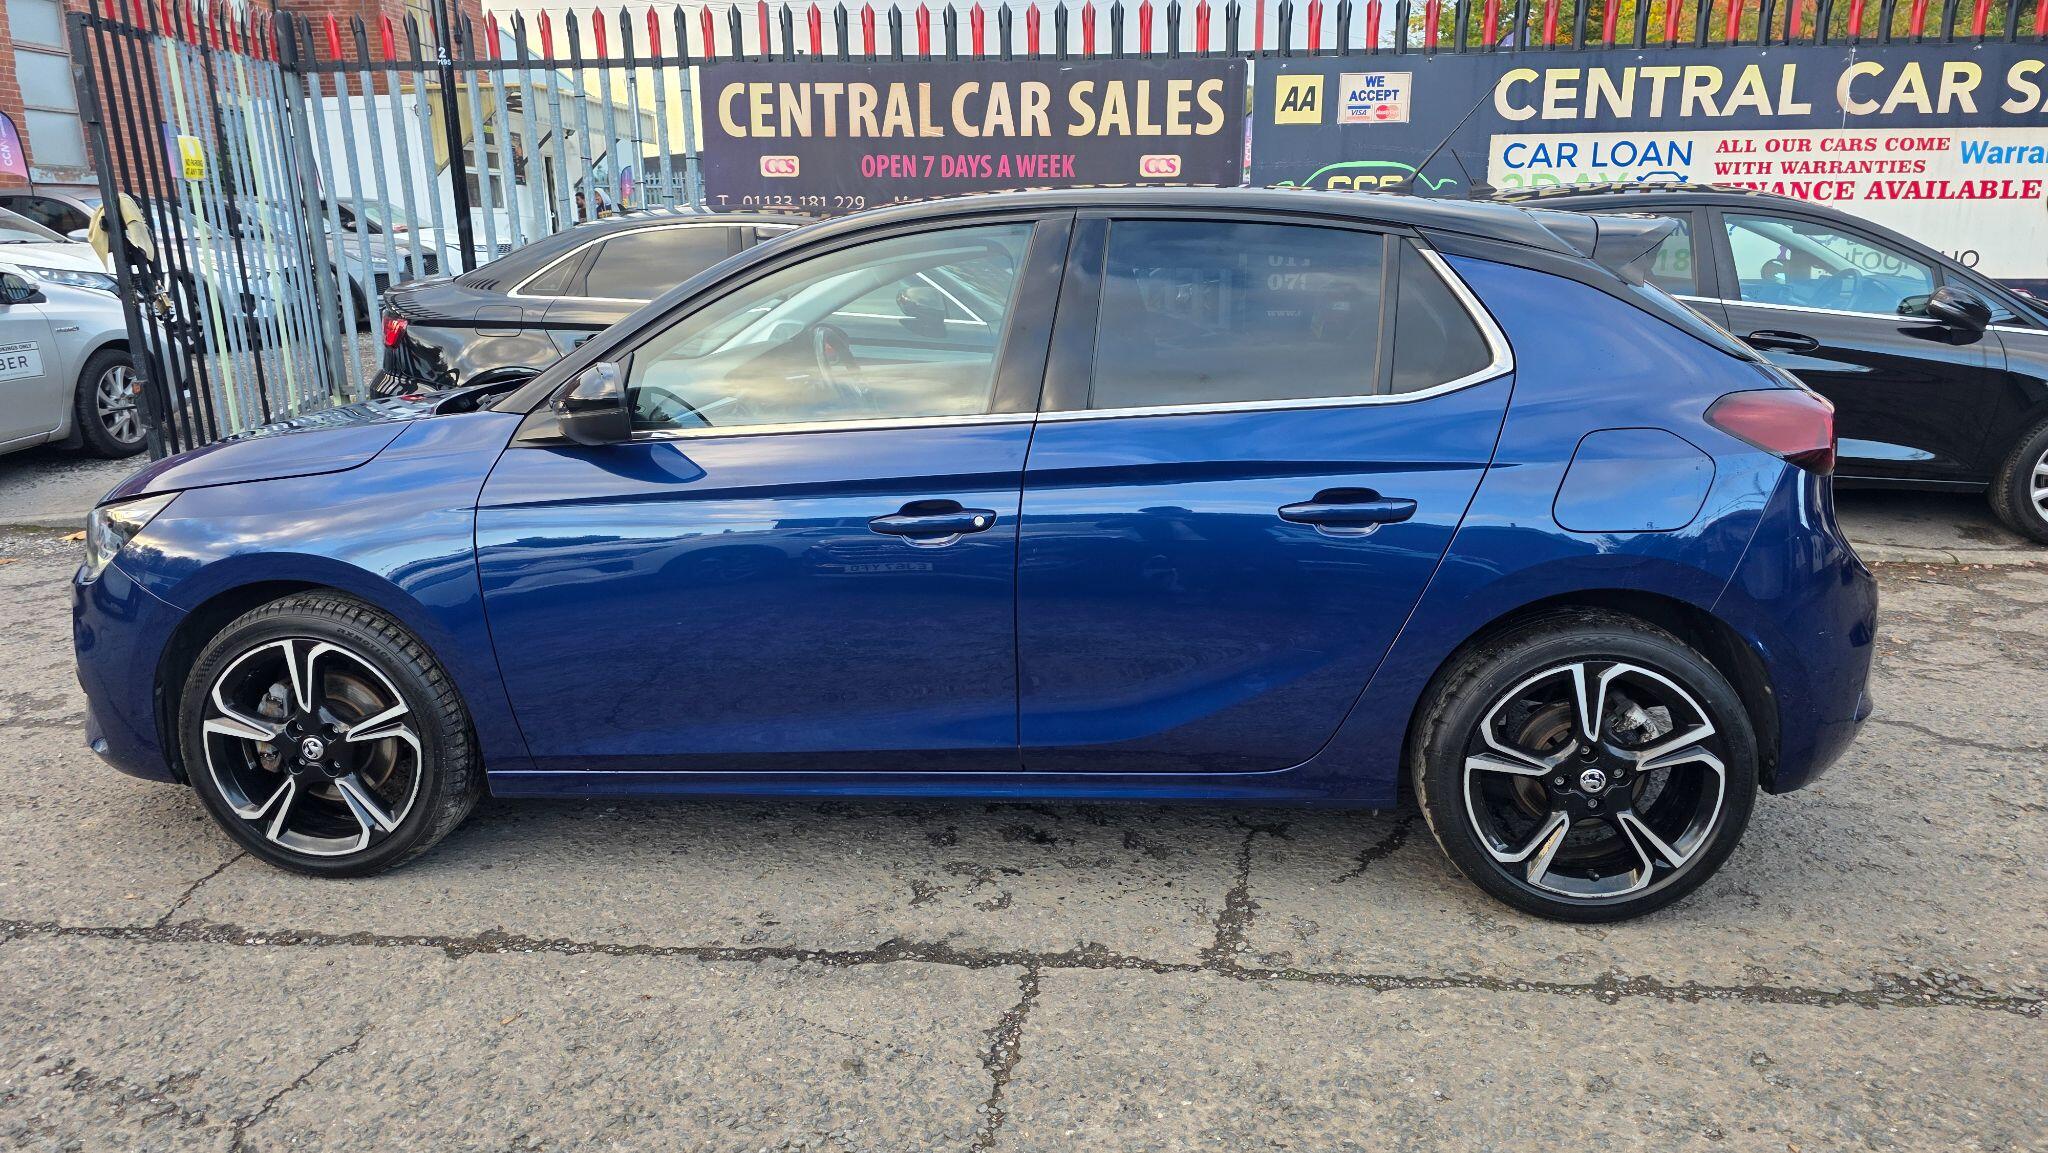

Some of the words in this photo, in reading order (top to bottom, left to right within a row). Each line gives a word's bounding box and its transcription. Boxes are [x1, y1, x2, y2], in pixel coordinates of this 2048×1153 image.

[1365, 75, 1385, 88] WE
[1280, 85, 1317, 112] AA
[1348, 89, 1400, 102] ACCEPT
[1493, 62, 1812, 122] CENTRAL
[1836, 61, 1983, 116] CAR
[2000, 59, 2048, 114] S
[718, 82, 945, 138] CENTRAL
[951, 81, 1051, 138] CAR
[1067, 78, 1225, 137] SALES
[1716, 139, 1757, 154] ALL
[1764, 138, 1812, 153] OUR
[1820, 137, 1877, 152] CARS
[1885, 137, 1951, 151] COME
[1503, 142, 1579, 169] CAR
[1591, 140, 1694, 168] LOAN
[764, 158, 796, 174] CCS
[861, 154, 917, 179] OPEN
[922, 154, 936, 179] 7
[941, 154, 992, 179] DAYS
[998, 154, 1011, 178] A
[1016, 153, 1077, 179] WEEK
[1143, 157, 1178, 174] CCS
[1714, 161, 1773, 175] WITH
[1780, 160, 1926, 174] WARRANTIES
[1712, 180, 1856, 201] NANCE
[1864, 179, 2043, 200] AVAILABLE
[799, 194, 826, 208] 181
[833, 194, 866, 210] 229
